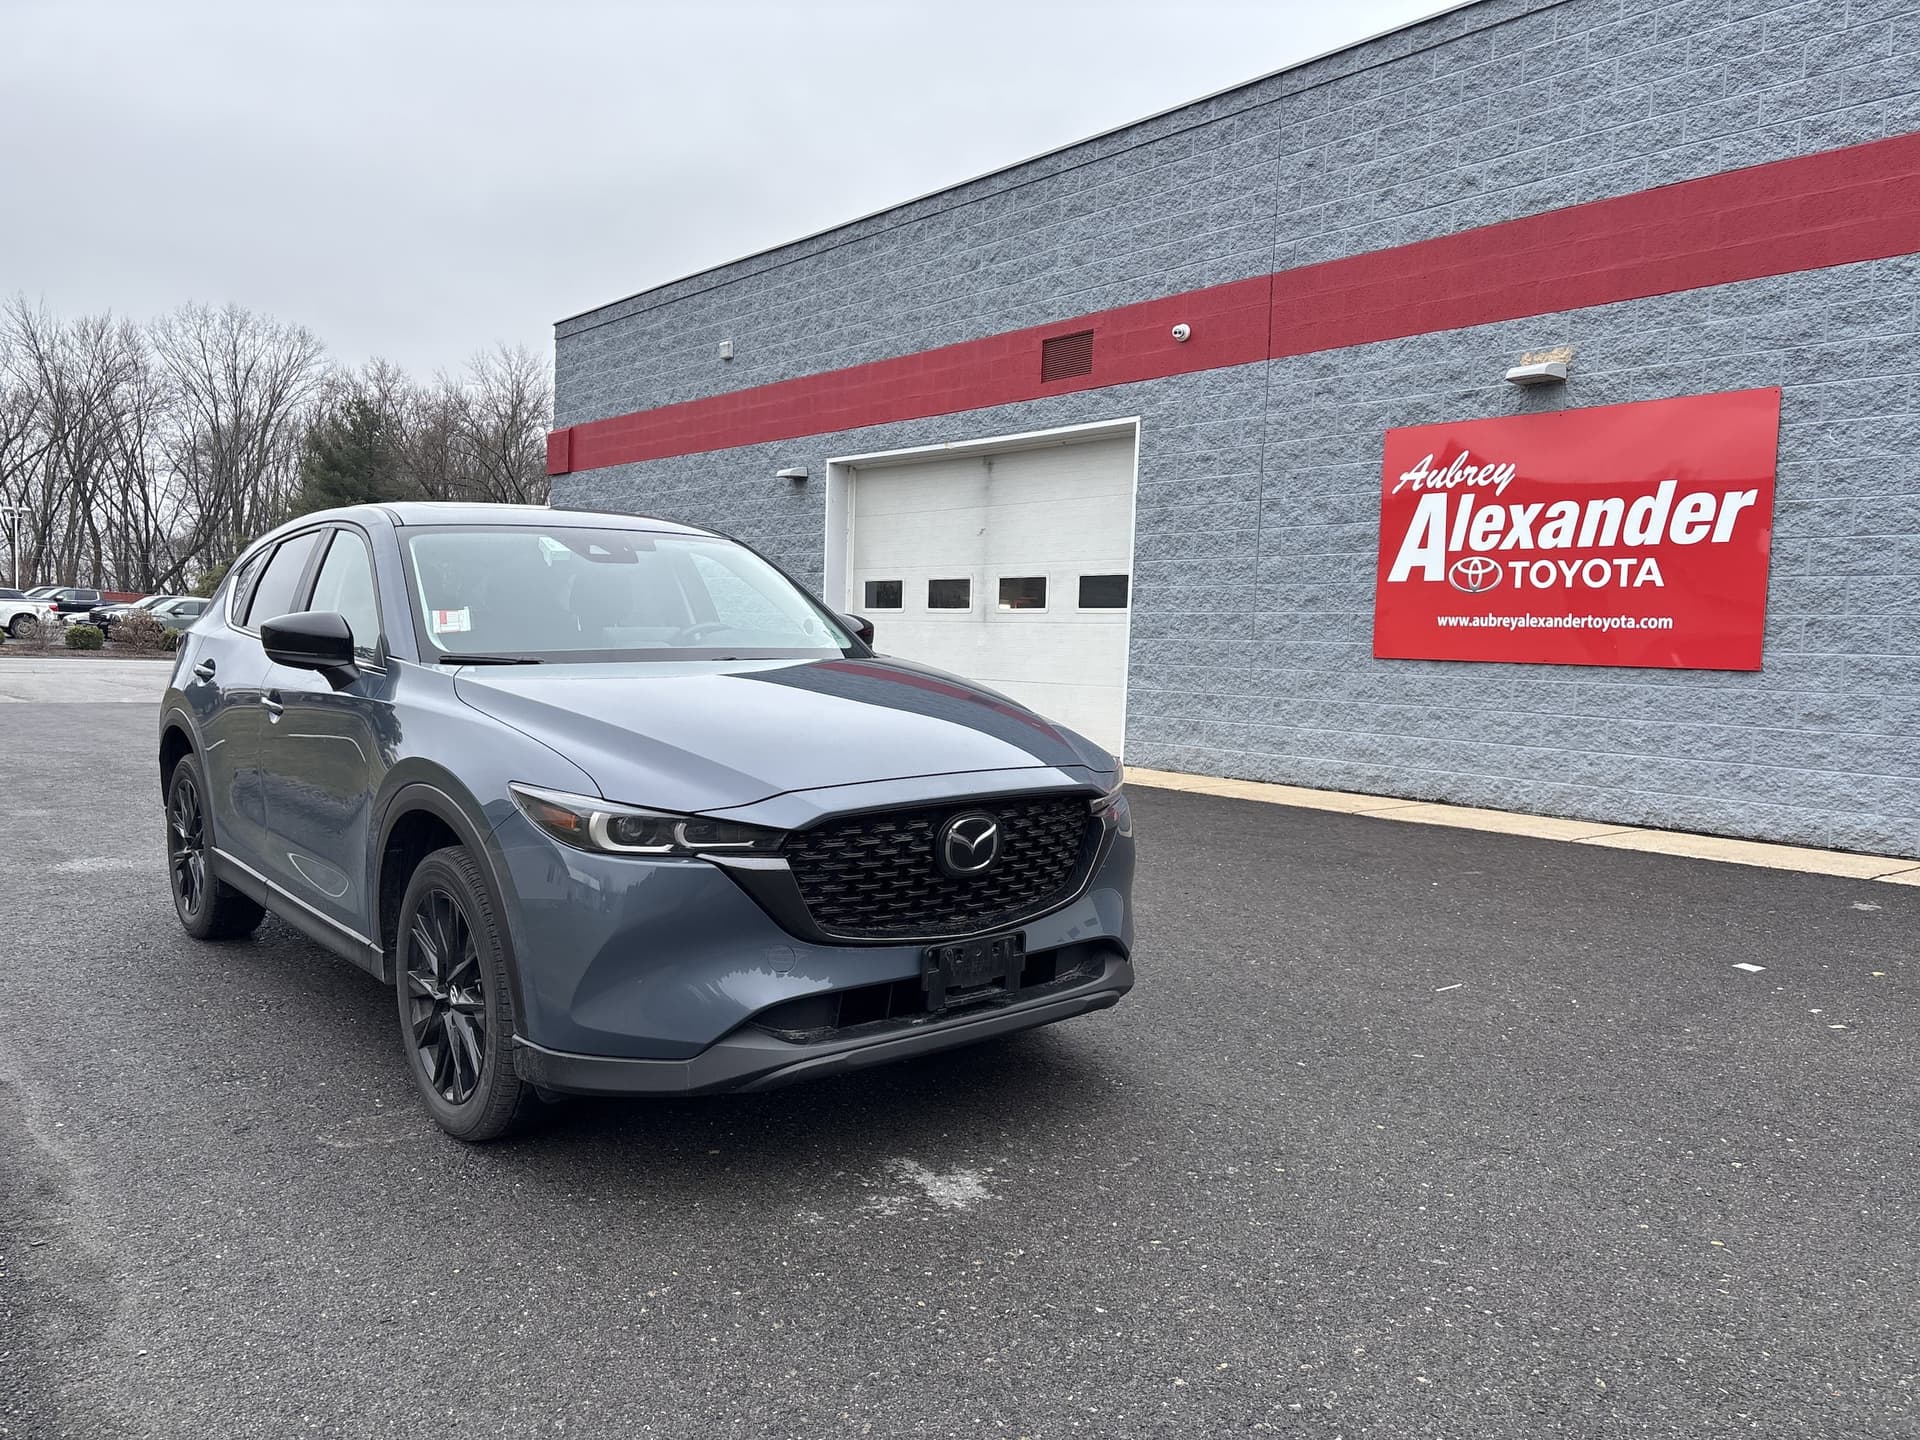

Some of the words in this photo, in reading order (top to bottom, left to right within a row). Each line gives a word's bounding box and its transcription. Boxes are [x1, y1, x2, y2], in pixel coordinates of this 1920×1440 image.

[1392, 449, 1516, 496] Aubrey
[1387, 480, 1758, 582] Alexander
[1508, 557, 1665, 589] TOYOTA
[1437, 612, 1674, 633] www.aubreyalexandertoyota.com
